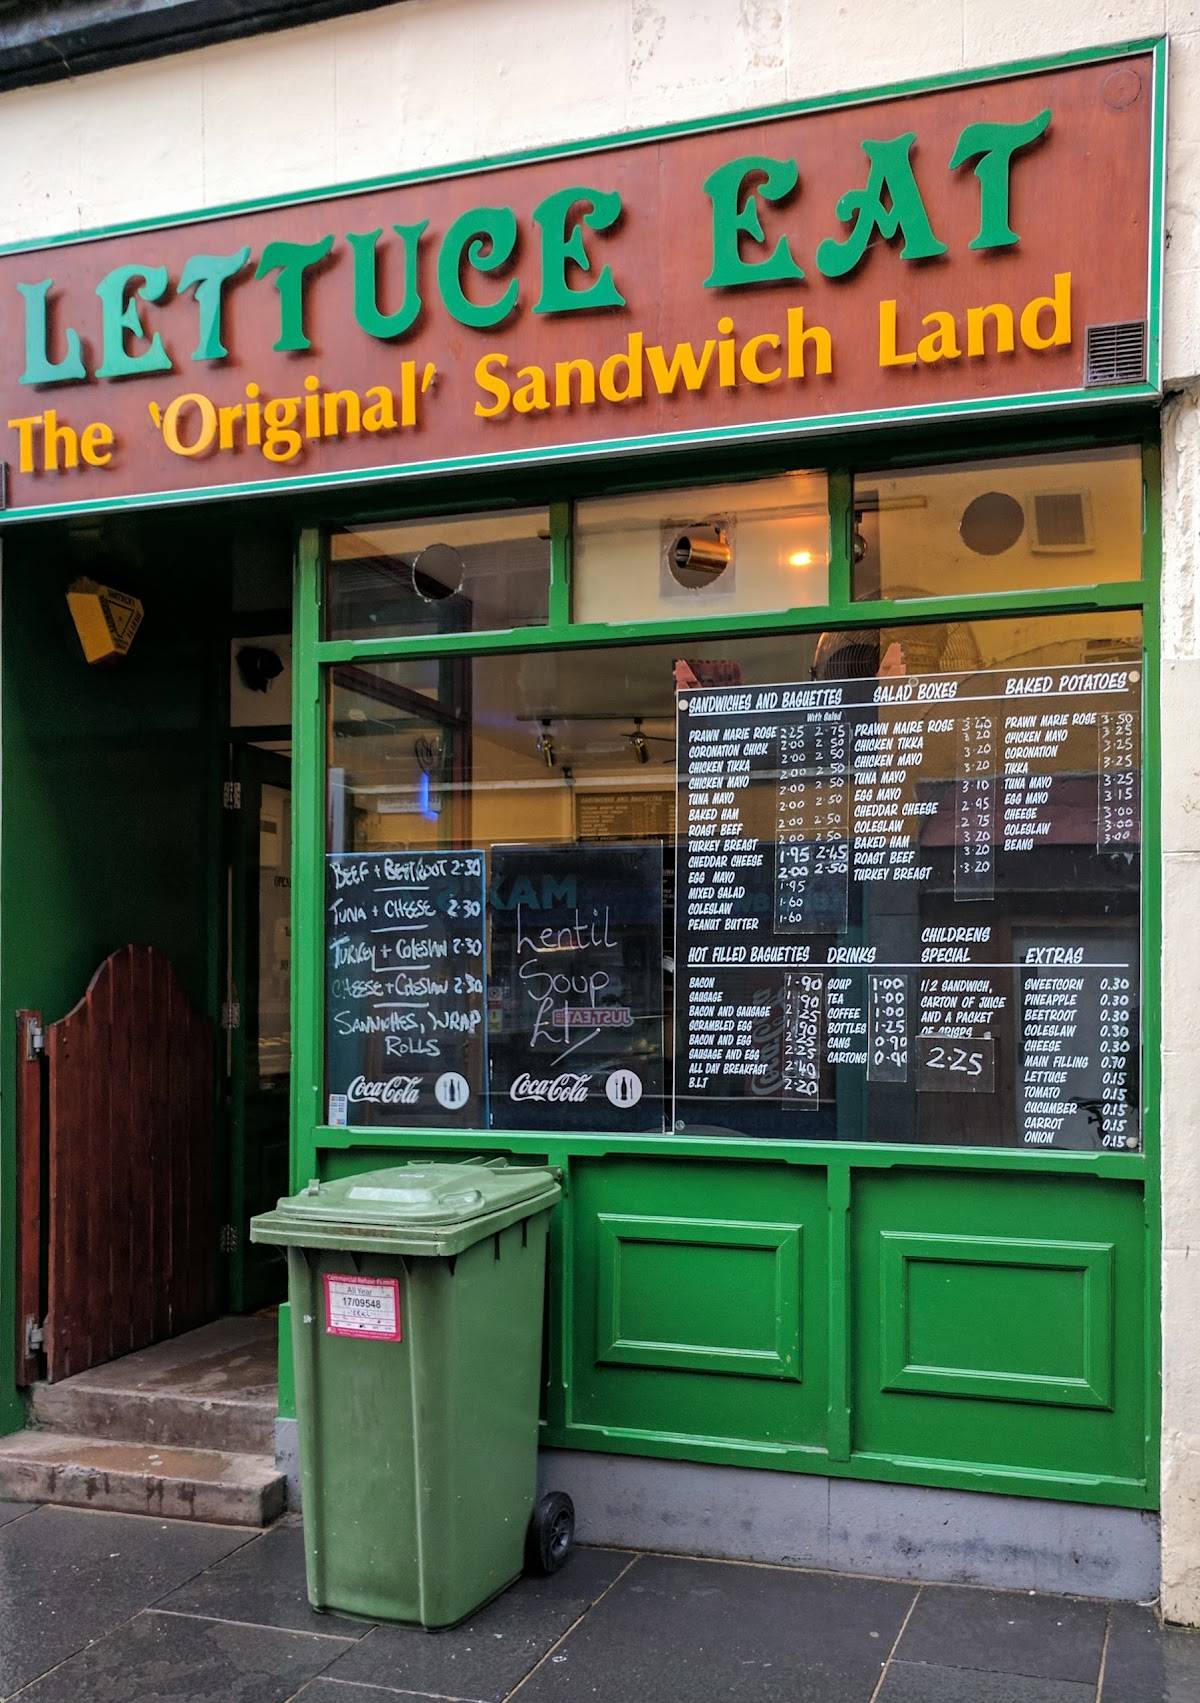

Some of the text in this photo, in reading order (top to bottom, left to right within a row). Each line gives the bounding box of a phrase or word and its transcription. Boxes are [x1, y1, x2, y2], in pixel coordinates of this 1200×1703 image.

[16, 107, 1052, 386] LETTUCE EAT
[8, 409, 114, 473] The
[474, 307, 833, 421] Sandwich
[878, 271, 1072, 368] Land
[1005, 672, 1127, 694] BAKED POTATOES
[873, 682, 958, 702] SALAD BOXES
[689, 688, 842, 713] SANDWICHES AND BAGUETTES
[1005, 713, 1097, 728] PRAWN MARIE ROSE
[689, 726, 777, 742] PRAWN MARIE ROSE
[855, 720, 954, 736] PRAWN MAIRE ROSE
[1005, 730, 1068, 743] CHICKEN MAYO
[689, 743, 768, 758] CORONATION CHICK
[855, 737, 923, 752] CHICKEN TIKKA
[1005, 746, 1058, 759] CORONATION
[689, 760, 750, 774] CHICKEN TIKKA
[854, 753, 923, 768] CHICKEN MAYO
[1005, 762, 1029, 774] TIKKA
[688, 776, 750, 790] CHICKEN MAYO
[854, 771, 906, 785] TUNA MAYO
[1004, 777, 1052, 790] TUNA MAYO
[689, 792, 734, 805] TUNA MAYO
[854, 788, 901, 802] EGG MAYO
[1004, 792, 1048, 804] EGG MAYO
[689, 808, 739, 821] BAKED HAM
[854, 803, 938, 817] CHEDDAR CHEESE
[1004, 808, 1037, 820] CHEESE
[688, 823, 743, 837] ROAST BEEF
[854, 820, 904, 833] COLESLAW
[1004, 823, 1051, 836] COLESLAW
[688, 839, 759, 852] TURKEY BREAST
[854, 836, 910, 849] BAKED HAM
[1004, 839, 1034, 850] BEANS
[688, 855, 764, 868] CHEDDAR CHEESE
[854, 851, 915, 865] ROAST BEEF
[688, 871, 735, 884] EGG MAYO
[854, 867, 932, 881] TURKEY BREAST
[688, 887, 745, 900] MIXED SALAD
[688, 903, 733, 915] COLESLAW
[688, 918, 759, 930] PEANUT BUTTER
[921, 927, 991, 942] CHILDRENS
[688, 946, 810, 962] HOT FILLED BAGUETTES
[827, 947, 876, 963] DRINKS
[921, 948, 970, 963] SPECIAL
[1025, 947, 1084, 964] EXTRAS
[519, 958, 610, 1008] Soup
[689, 977, 715, 988] BACON
[827, 979, 852, 990] SOUP
[920, 980, 992, 993] 1/2 SANDWICH,
[1024, 978, 1129, 990] SWEETCORN 0.30
[689, 992, 723, 1002] SAUSAGE
[827, 994, 844, 1004] TEA
[921, 996, 1006, 1008] CARTON OF JUICE
[1024, 994, 1129, 1006] PINEAPPLE 0.30
[689, 1006, 771, 1017] BACON AND SAUSAGE
[827, 1008, 861, 1019] COFFEE
[921, 1012, 993, 1023] AND A PACKET
[1024, 1010, 1077, 1021] BEETROOT
[689, 1020, 752, 1031] SCRAMBLED EGG
[827, 1023, 866, 1034] BOTTLES
[1024, 1025, 1077, 1037] COLESLAW
[689, 1035, 752, 1045] BACON AND EGG
[827, 1038, 850, 1048] CANS
[1024, 1041, 1061, 1052] CHEESE
[689, 1049, 760, 1060] SAUSAGE AND EGG
[827, 1052, 867, 1063] CARTONS
[1024, 1056, 1049, 1067] MAIN
[1053, 1056, 1088, 1068] FILLING
[689, 1063, 768, 1075] ALL DAY BREAKFAST
[1024, 1071, 1127, 1085] LETTUCE 0.15
[1024, 1087, 1060, 1098] TOMATO
[1024, 1103, 1078, 1114] CUCUMBER
[1024, 1118, 1064, 1129] CARROT
[1024, 1132, 1054, 1143] ONION
[343, 1298, 381, 1309] 17/09548
